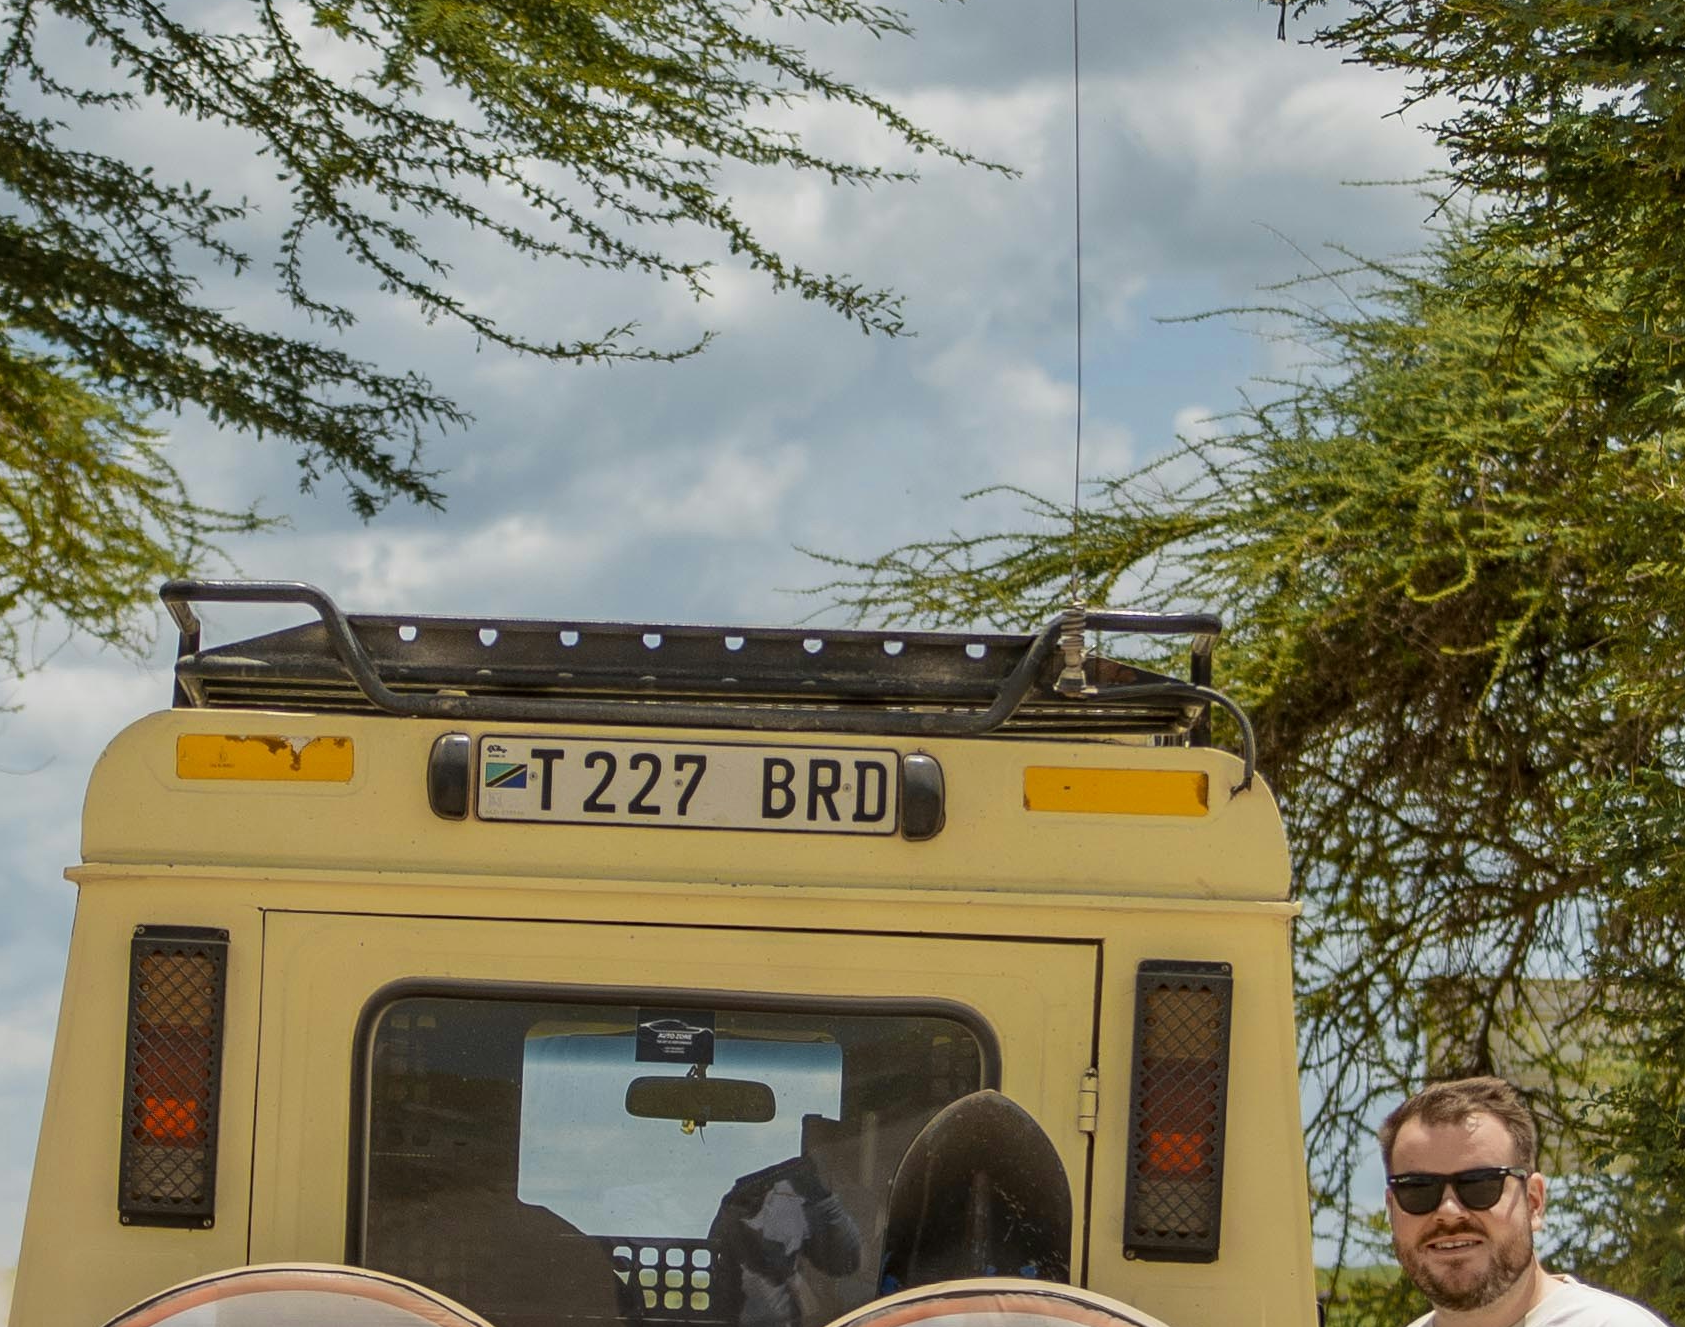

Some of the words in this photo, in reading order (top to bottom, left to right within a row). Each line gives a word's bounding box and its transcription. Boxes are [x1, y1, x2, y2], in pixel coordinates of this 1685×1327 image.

[530, 748, 565, 812] T
[582, 750, 708, 816] 227
[761, 756, 888, 823] BRD
